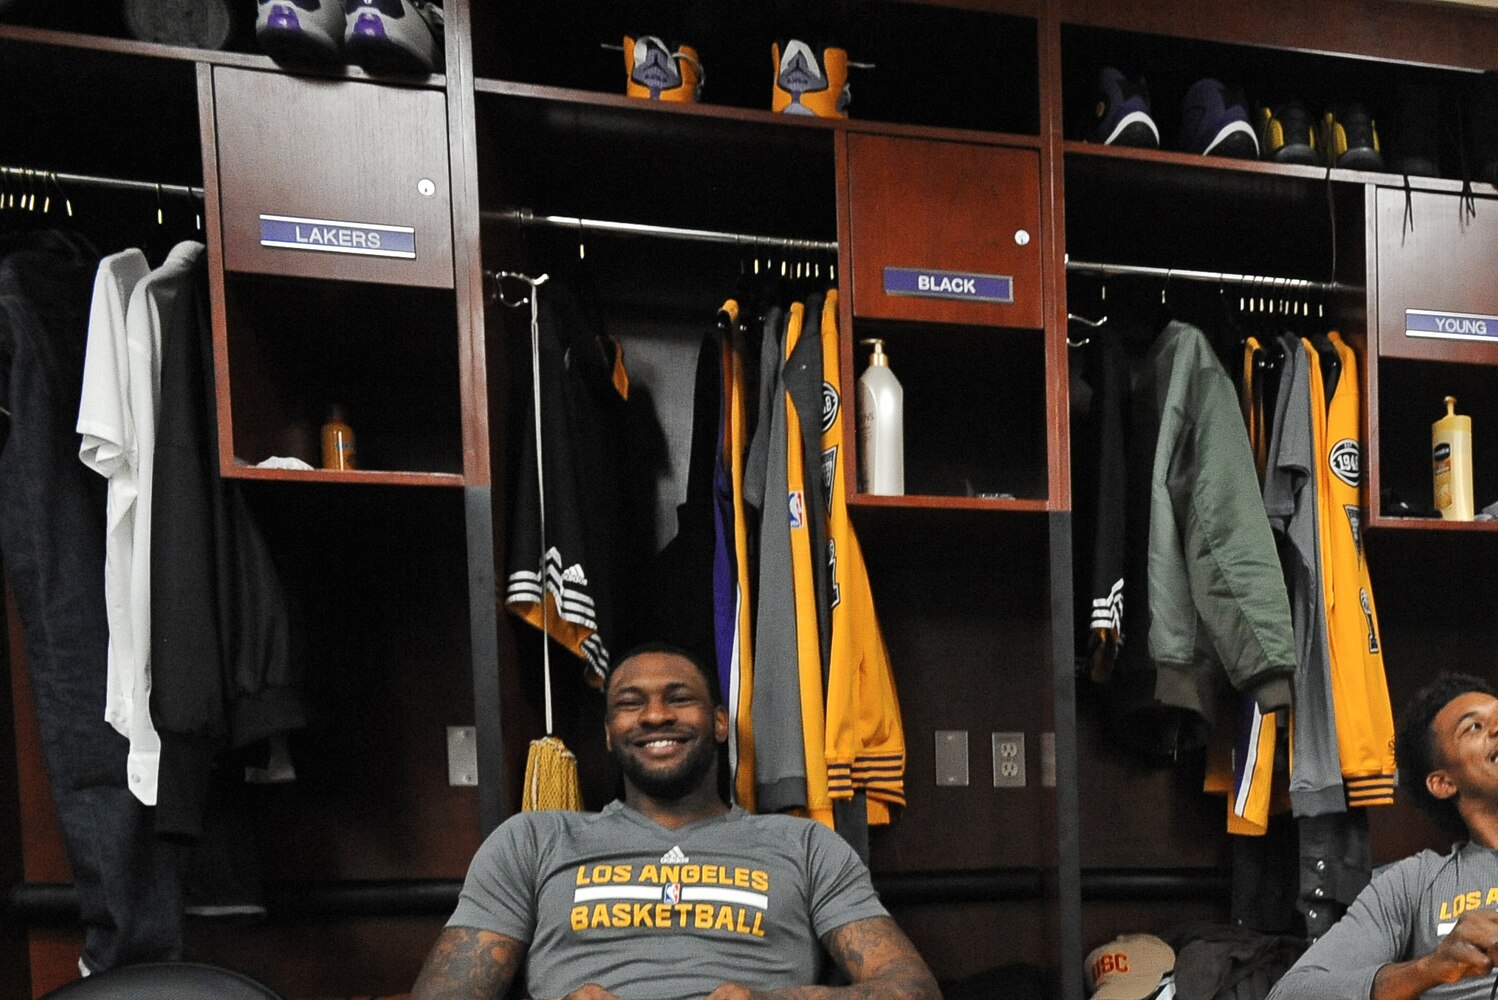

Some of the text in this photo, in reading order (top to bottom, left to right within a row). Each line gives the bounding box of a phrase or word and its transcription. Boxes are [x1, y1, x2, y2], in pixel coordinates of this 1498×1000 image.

[295, 225, 381, 248] LAKERS
[917, 275, 976, 294] BLACK
[1435, 317, 1487, 335] YOUNG
[576, 864, 769, 892] LOS ANGELES
[1440, 890, 1482, 920] LOS
[570, 903, 766, 938] BASKETBALL
